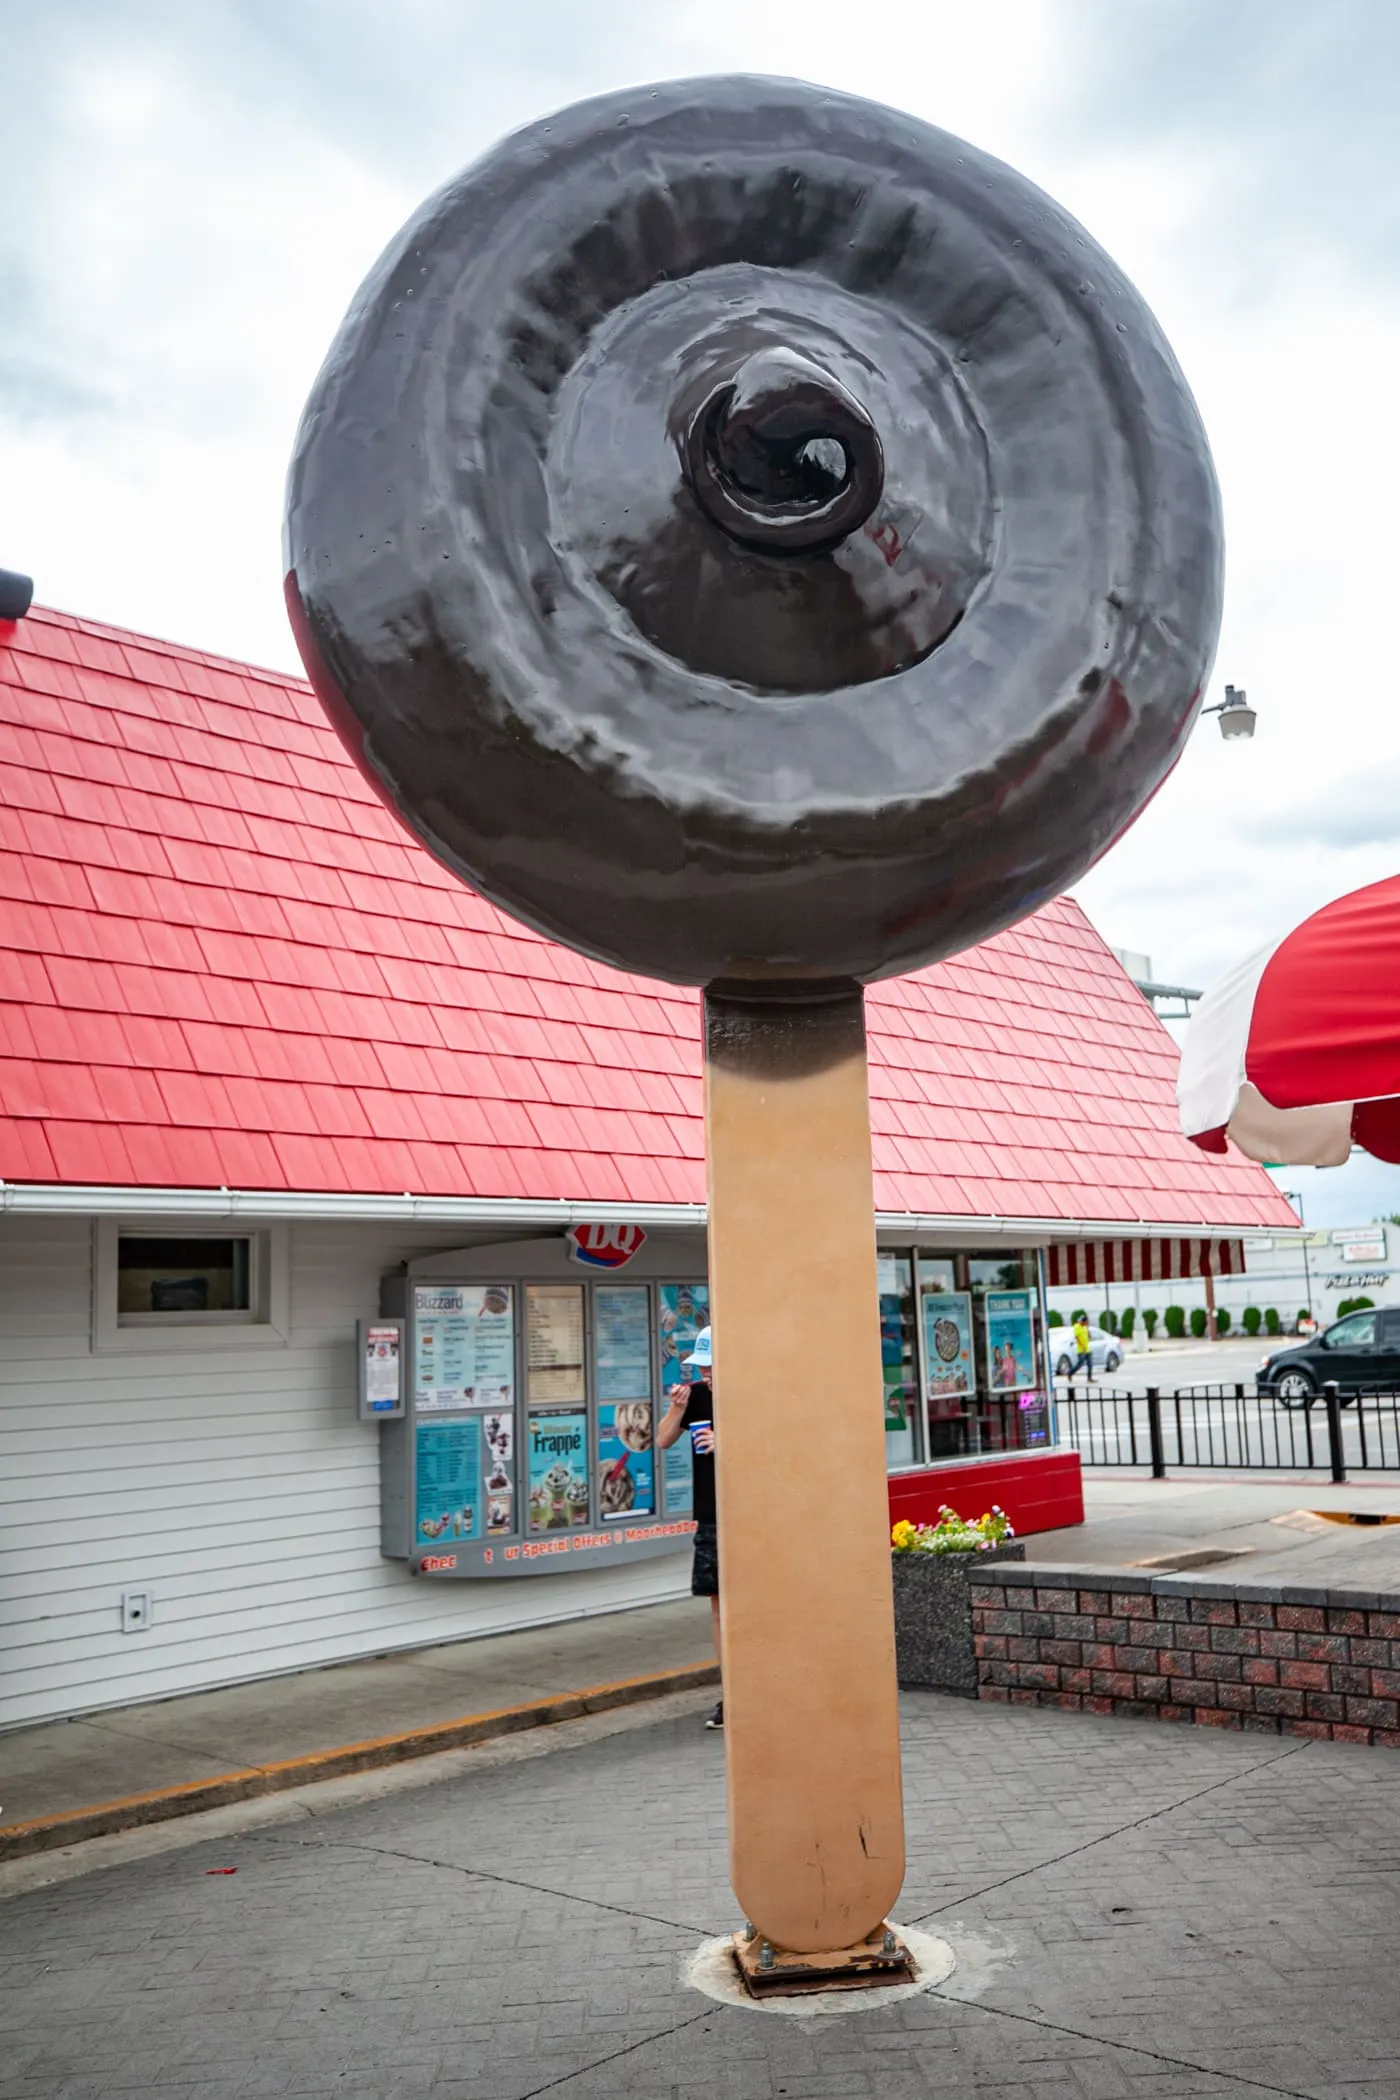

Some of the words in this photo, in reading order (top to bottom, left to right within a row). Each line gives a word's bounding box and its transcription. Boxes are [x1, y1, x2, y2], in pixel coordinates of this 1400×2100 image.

[585, 1224, 635, 1254] DQ
[415, 1292, 463, 1310] Blizzard
[534, 1426, 581, 1457] Frappé
[521, 1536, 570, 1560] Special
[572, 1532, 611, 1551] Offers
